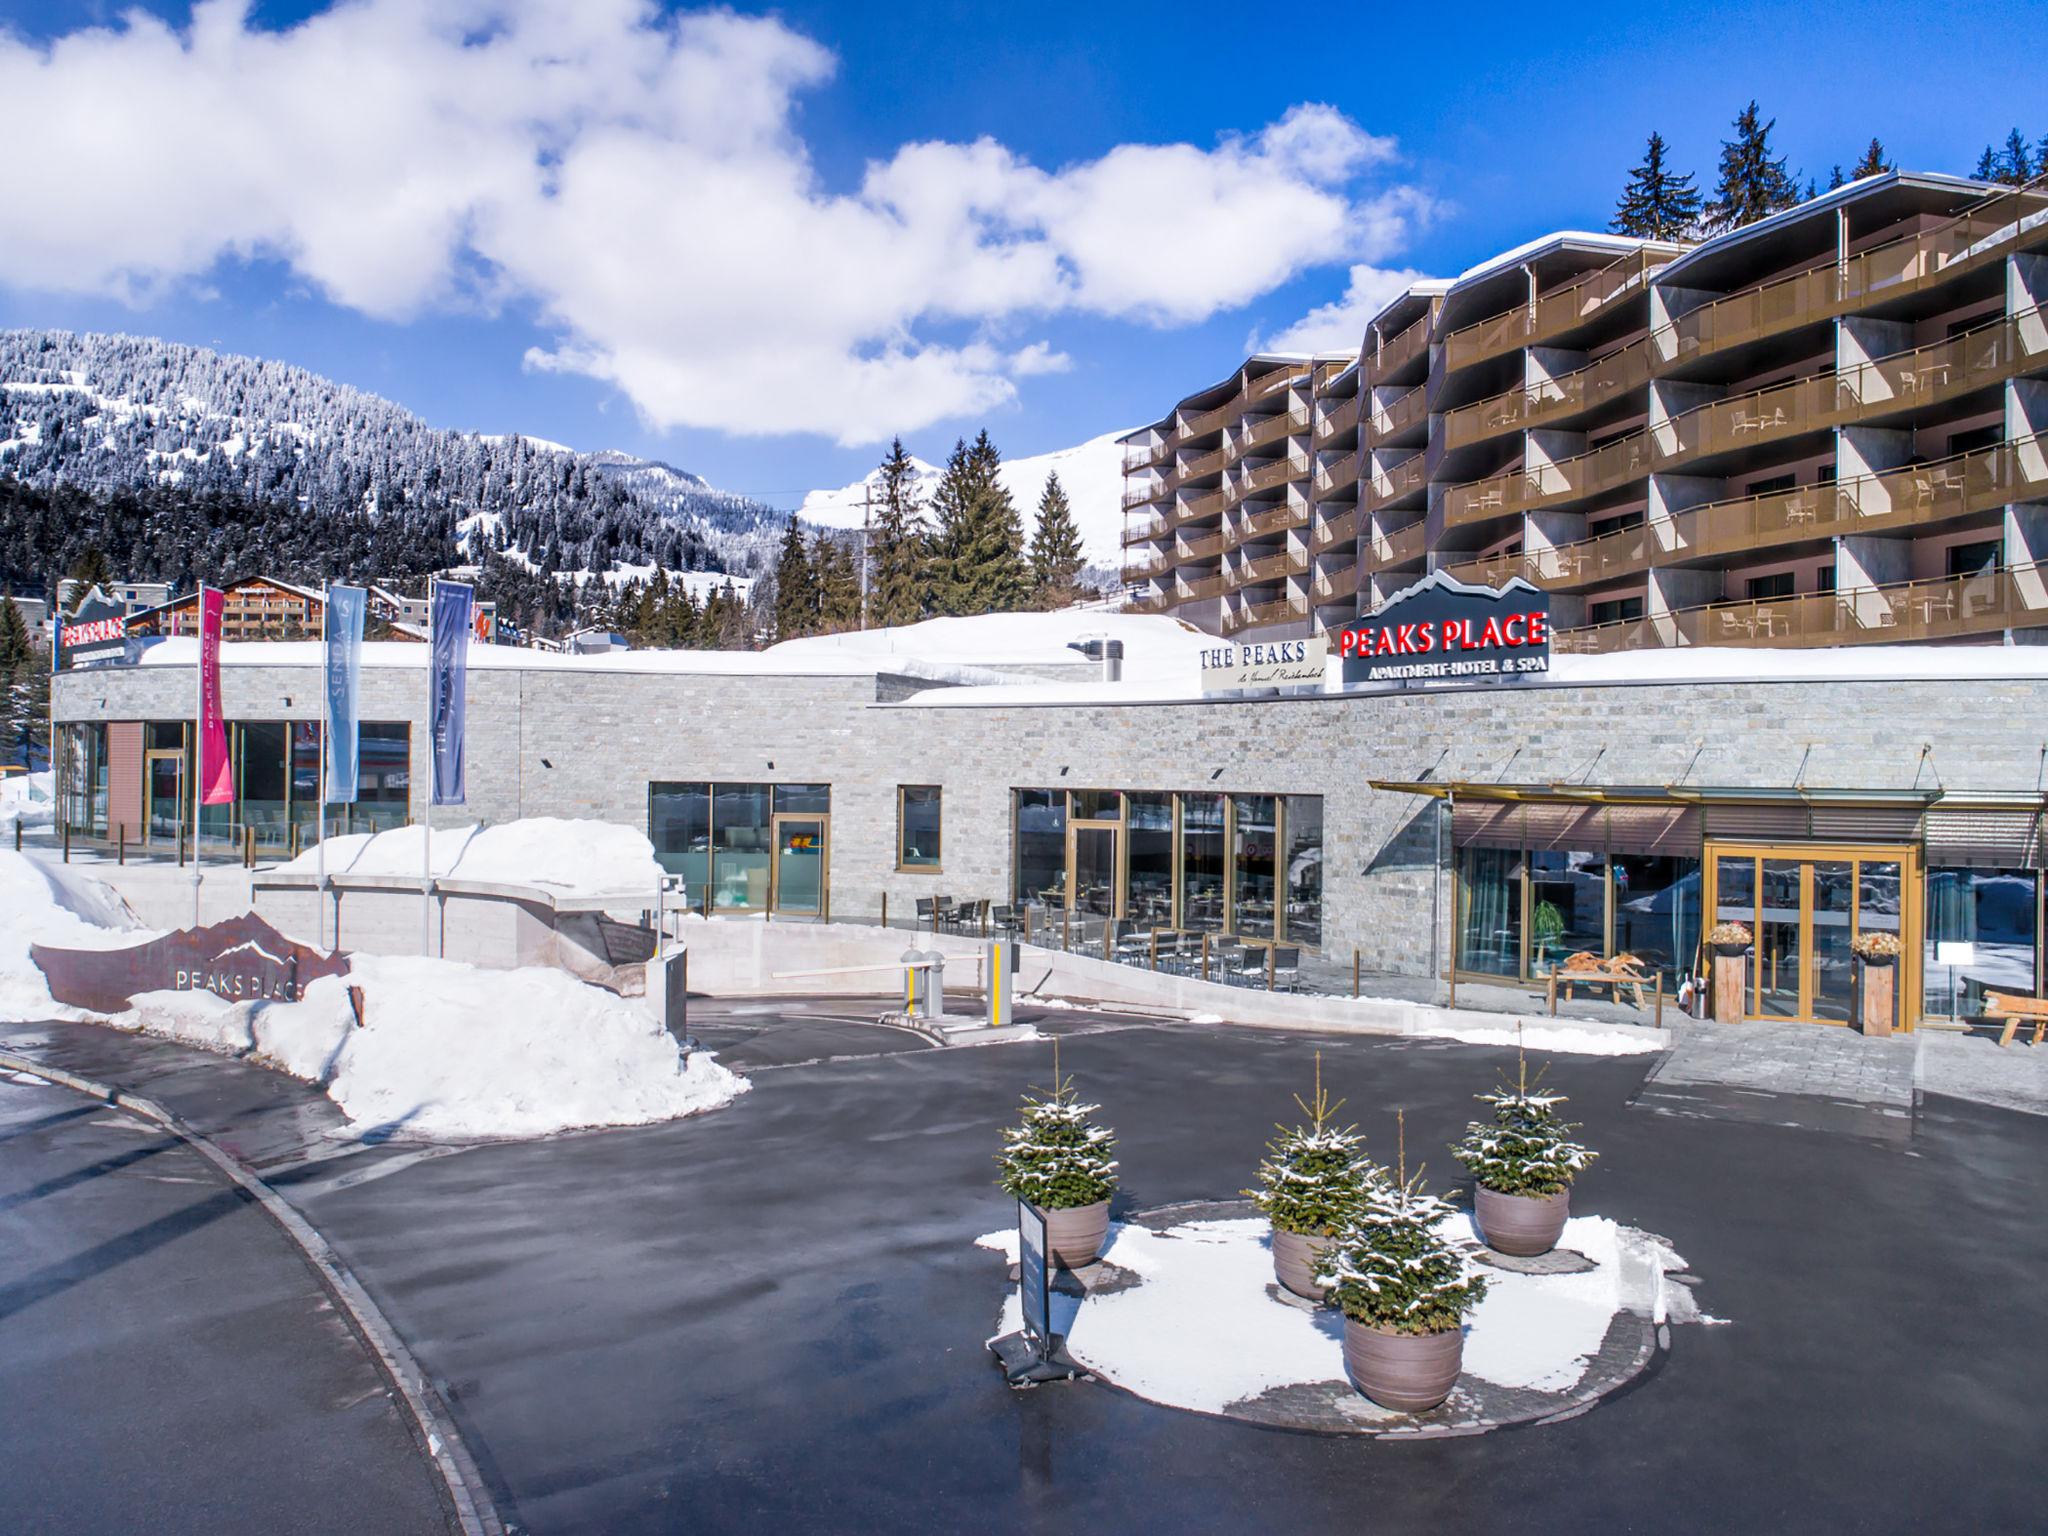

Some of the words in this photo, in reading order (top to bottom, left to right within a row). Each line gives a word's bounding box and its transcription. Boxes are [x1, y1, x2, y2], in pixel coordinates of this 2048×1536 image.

[64, 623, 93, 648] PEAKS
[93, 616, 126, 642] PLACE
[1341, 623, 1435, 658] PEAKS
[1442, 612, 1549, 650] PLACE
[203, 632, 211, 677] PLACE
[332, 631, 345, 698] SENDA
[1200, 649, 1234, 669] THE
[1242, 641, 1306, 667] PEAKS
[1368, 660, 1499, 680] APARTMENT-HOTEL
[1501, 659, 1515, 672] &
[1516, 656, 1548, 672] SPA
[439, 651, 450, 710] PEAKS
[205, 683, 214, 729] PEAKS
[436, 720, 447, 755] THE
[176, 970, 243, 996] PEAKS
[250, 977, 304, 1001] PLACE
